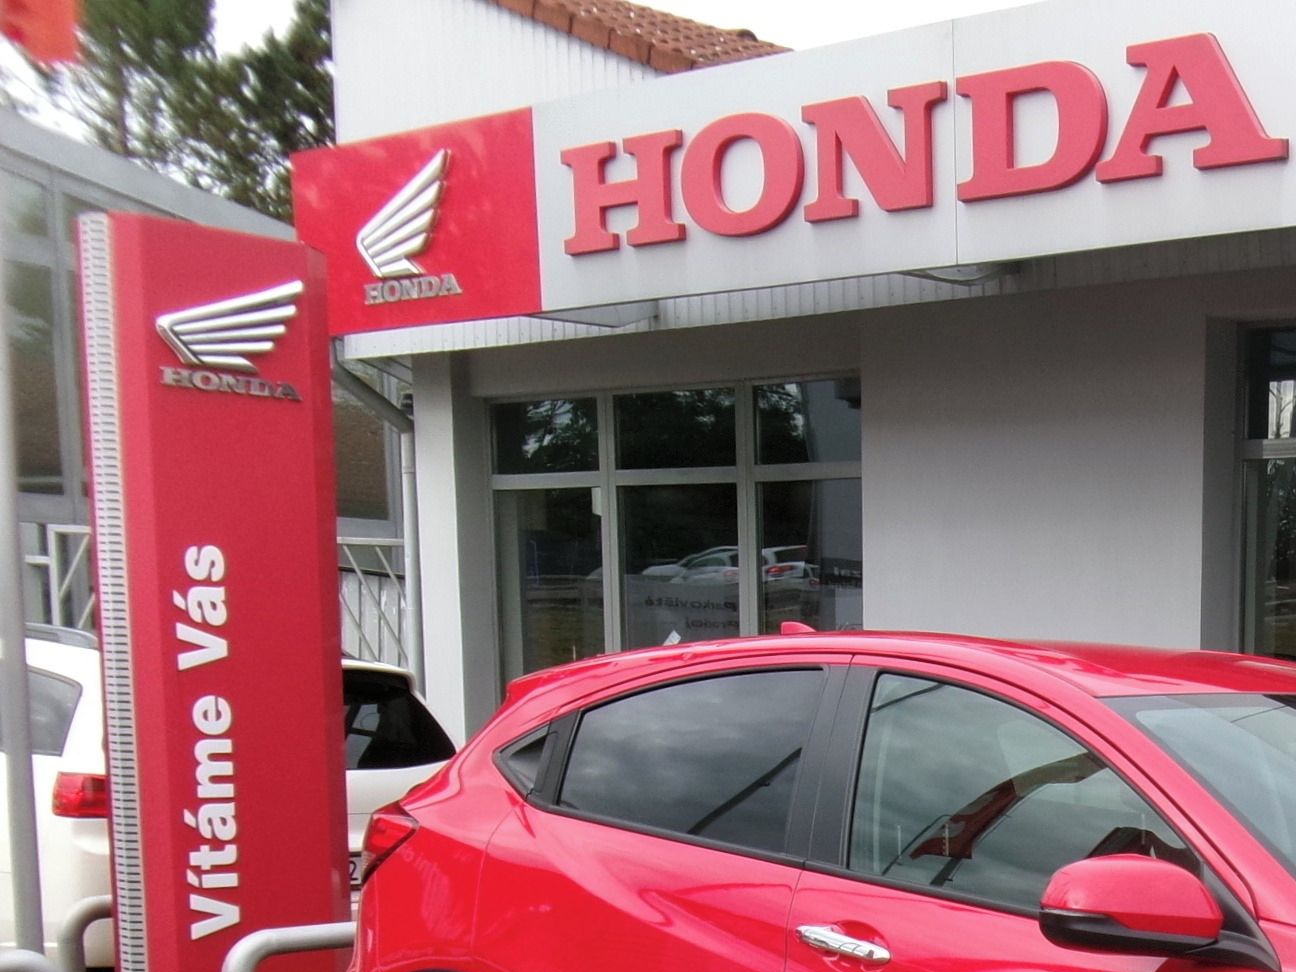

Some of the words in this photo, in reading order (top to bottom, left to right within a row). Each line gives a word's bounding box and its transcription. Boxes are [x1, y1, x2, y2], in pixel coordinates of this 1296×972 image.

[560, 32, 1289, 255] HONDA
[364, 273, 463, 305] HONDA
[159, 365, 303, 401] HONDA
[172, 544, 229, 671] Vás
[184, 695, 241, 941] Vítáme
